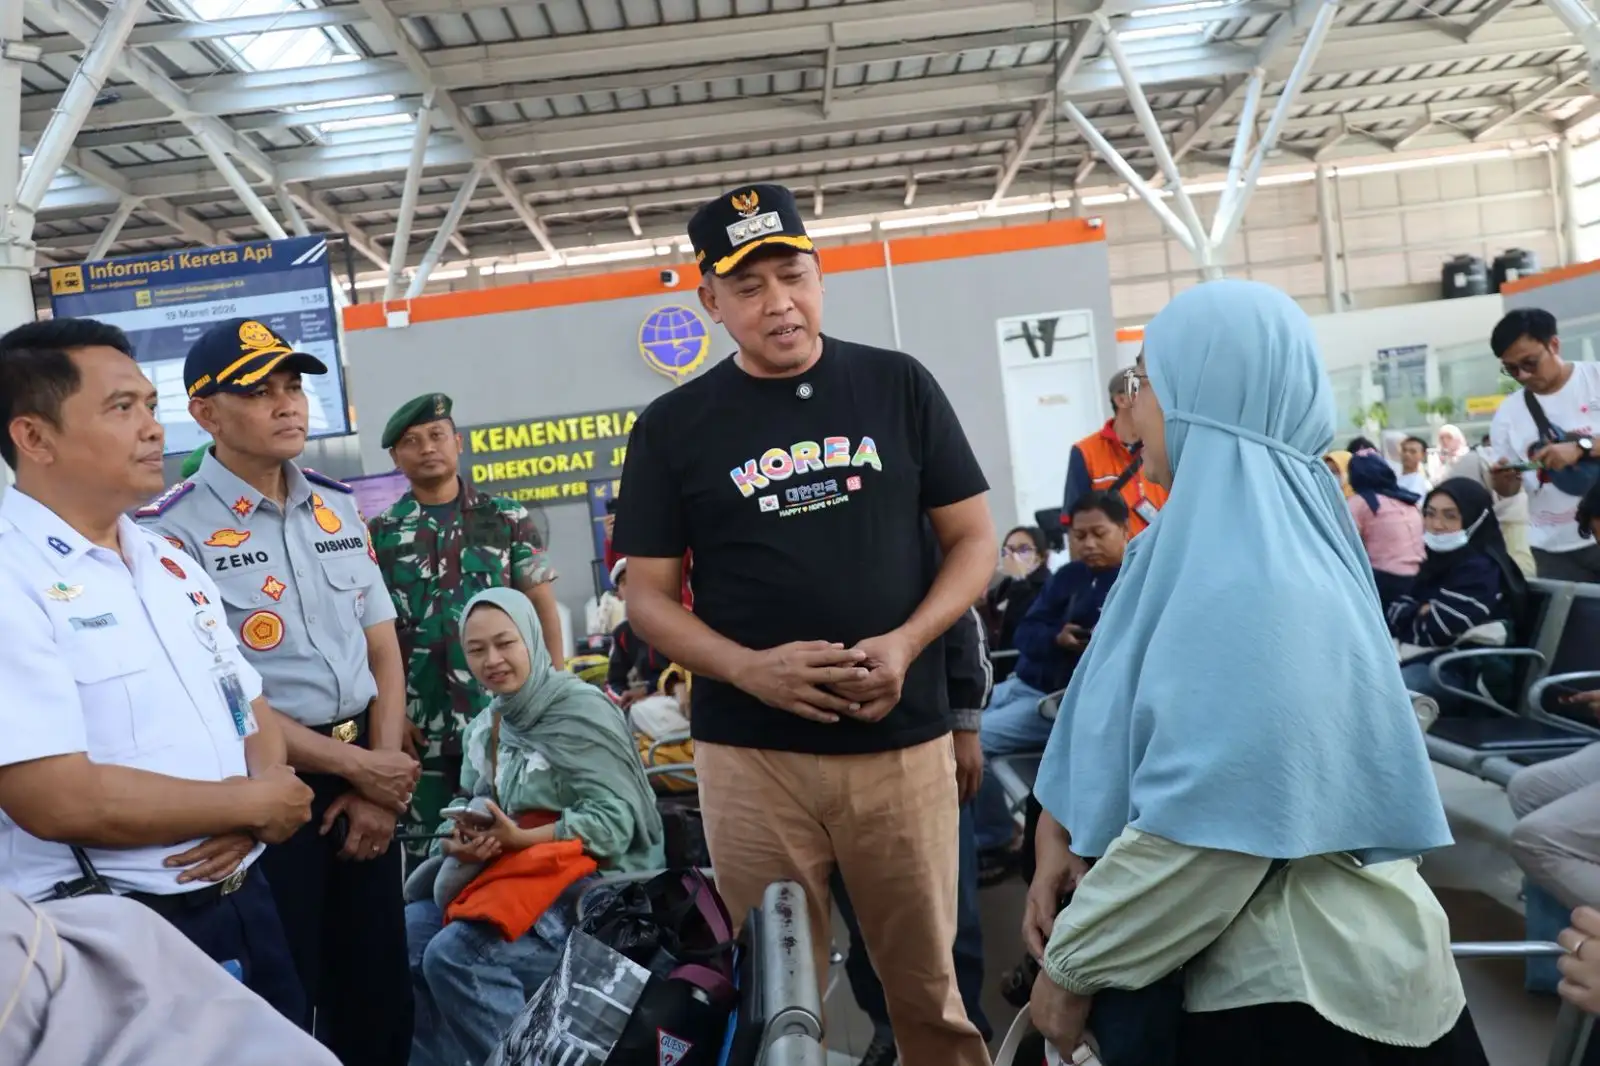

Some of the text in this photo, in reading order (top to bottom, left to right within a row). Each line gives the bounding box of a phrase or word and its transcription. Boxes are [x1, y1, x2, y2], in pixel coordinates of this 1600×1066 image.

[89, 255, 175, 279] Informasi
[178, 250, 239, 269] Kereta
[243, 243, 273, 263] Api
[469, 410, 638, 454] KEMENTERIA
[471, 451, 595, 483] DIREKTORAT
[729, 436, 883, 499] KOREA
[785, 479, 838, 502] 대한민국
[779, 494, 849, 517] HAPPY HOPE LOVE
[314, 537, 364, 554] DISHUB
[214, 551, 269, 571] ZENO
